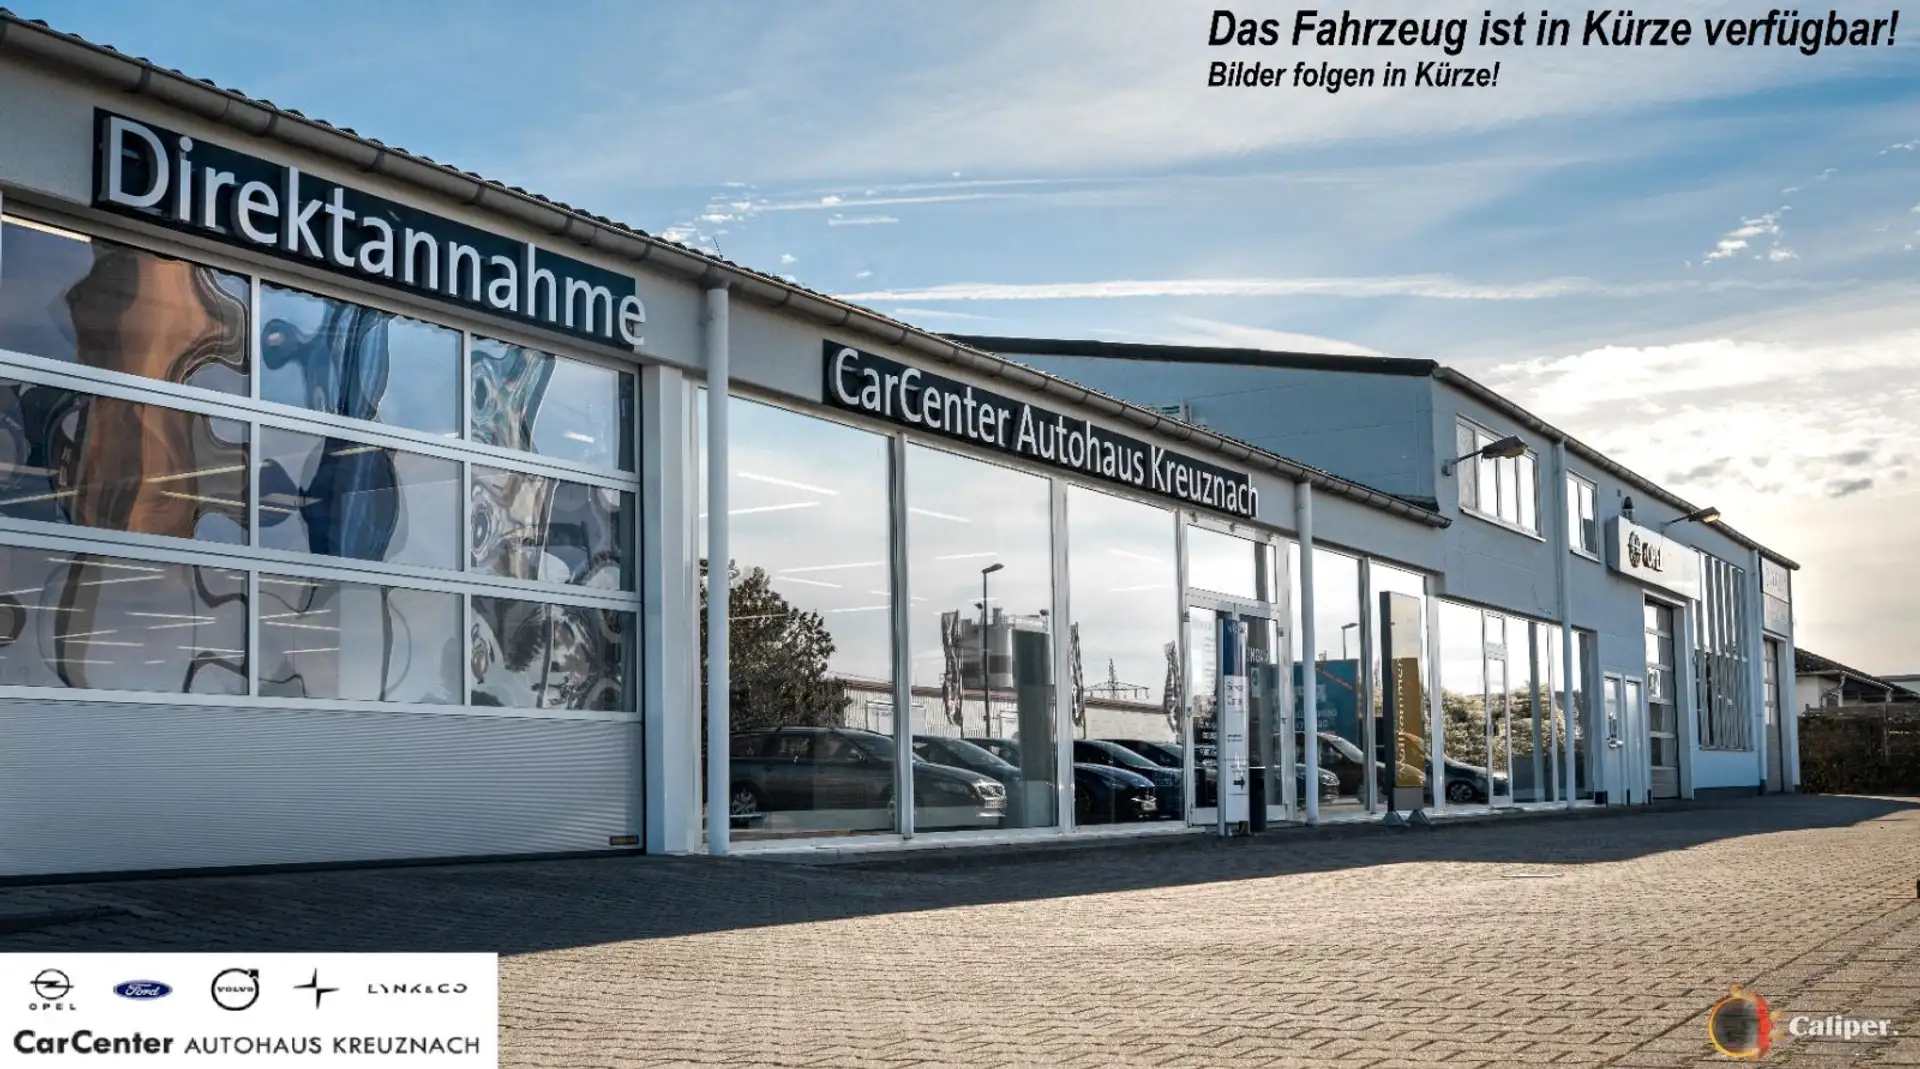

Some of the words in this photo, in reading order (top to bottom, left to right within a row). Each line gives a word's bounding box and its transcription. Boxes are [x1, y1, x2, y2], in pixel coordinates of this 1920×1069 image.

[106, 115, 646, 345] Direktannahme
[833, 347, 1011, 448] CarCenter
[1016, 403, 1145, 486] Autohaus
[1150, 444, 1259, 518] Kreuznach
